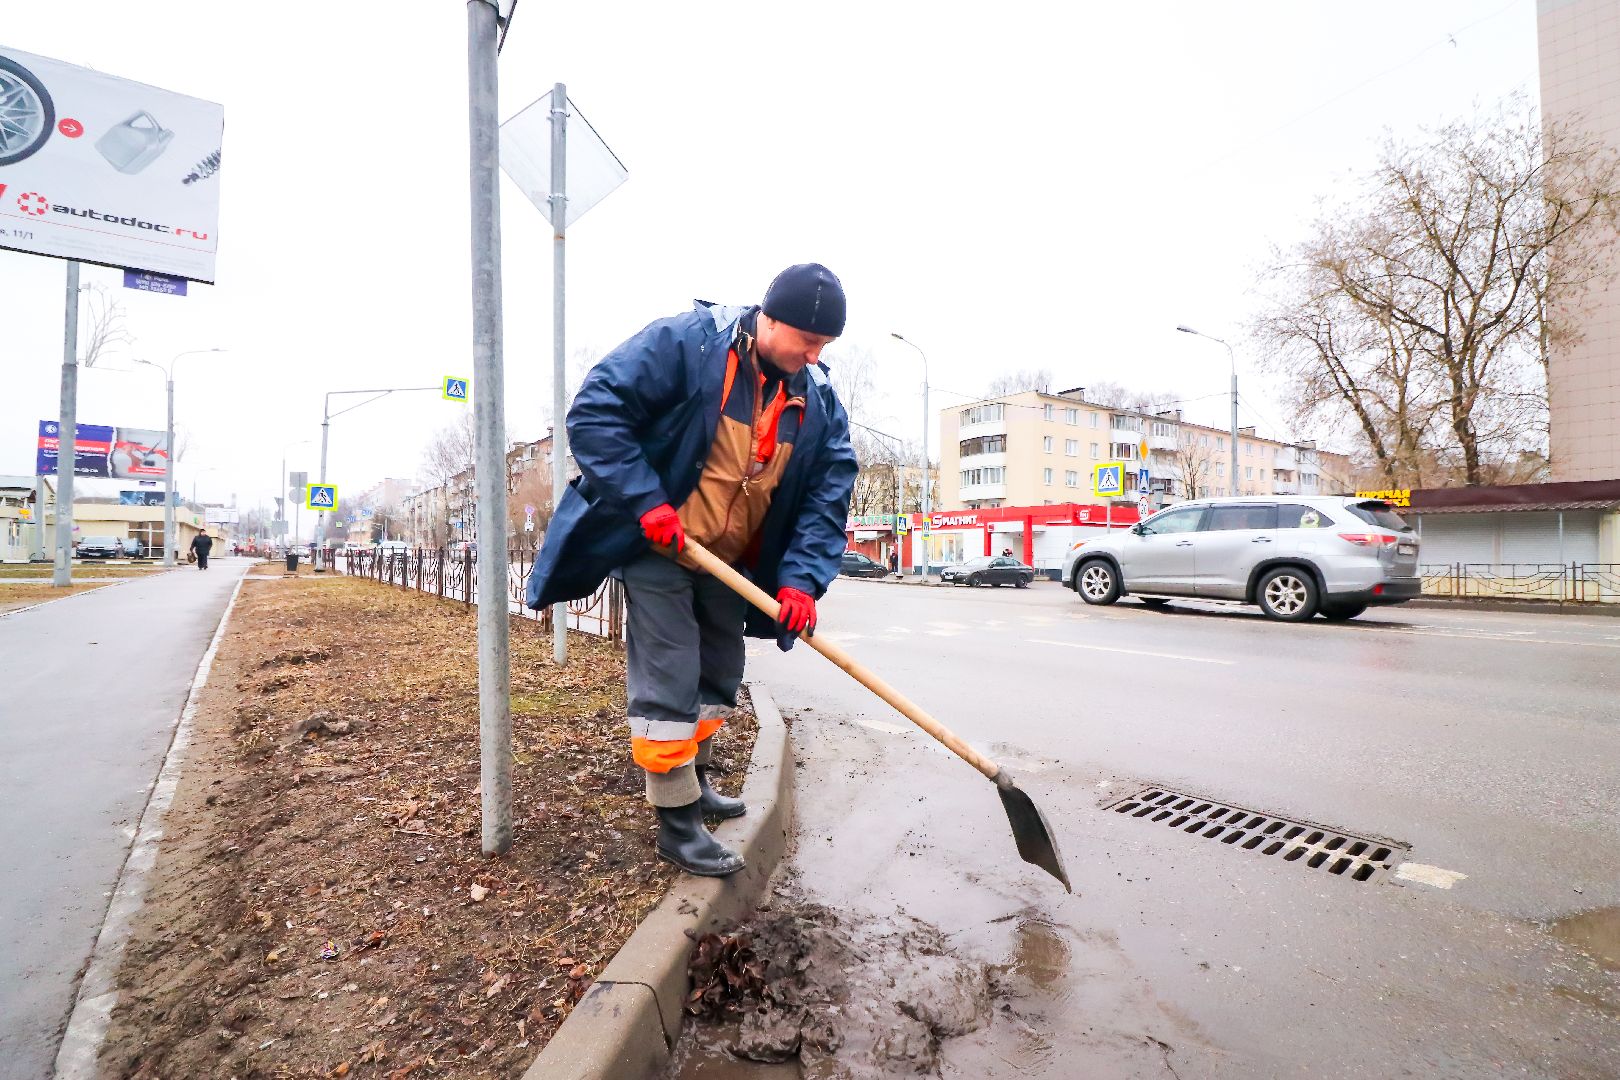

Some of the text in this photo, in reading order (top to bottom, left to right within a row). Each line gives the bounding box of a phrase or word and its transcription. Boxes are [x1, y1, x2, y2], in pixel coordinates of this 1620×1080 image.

[52, 203, 208, 240] autodoc.ru
[13, 229, 33, 240] 11/1
[860, 515, 894, 526] АПТЕК
[942, 515, 978, 526] МАГНИТ
